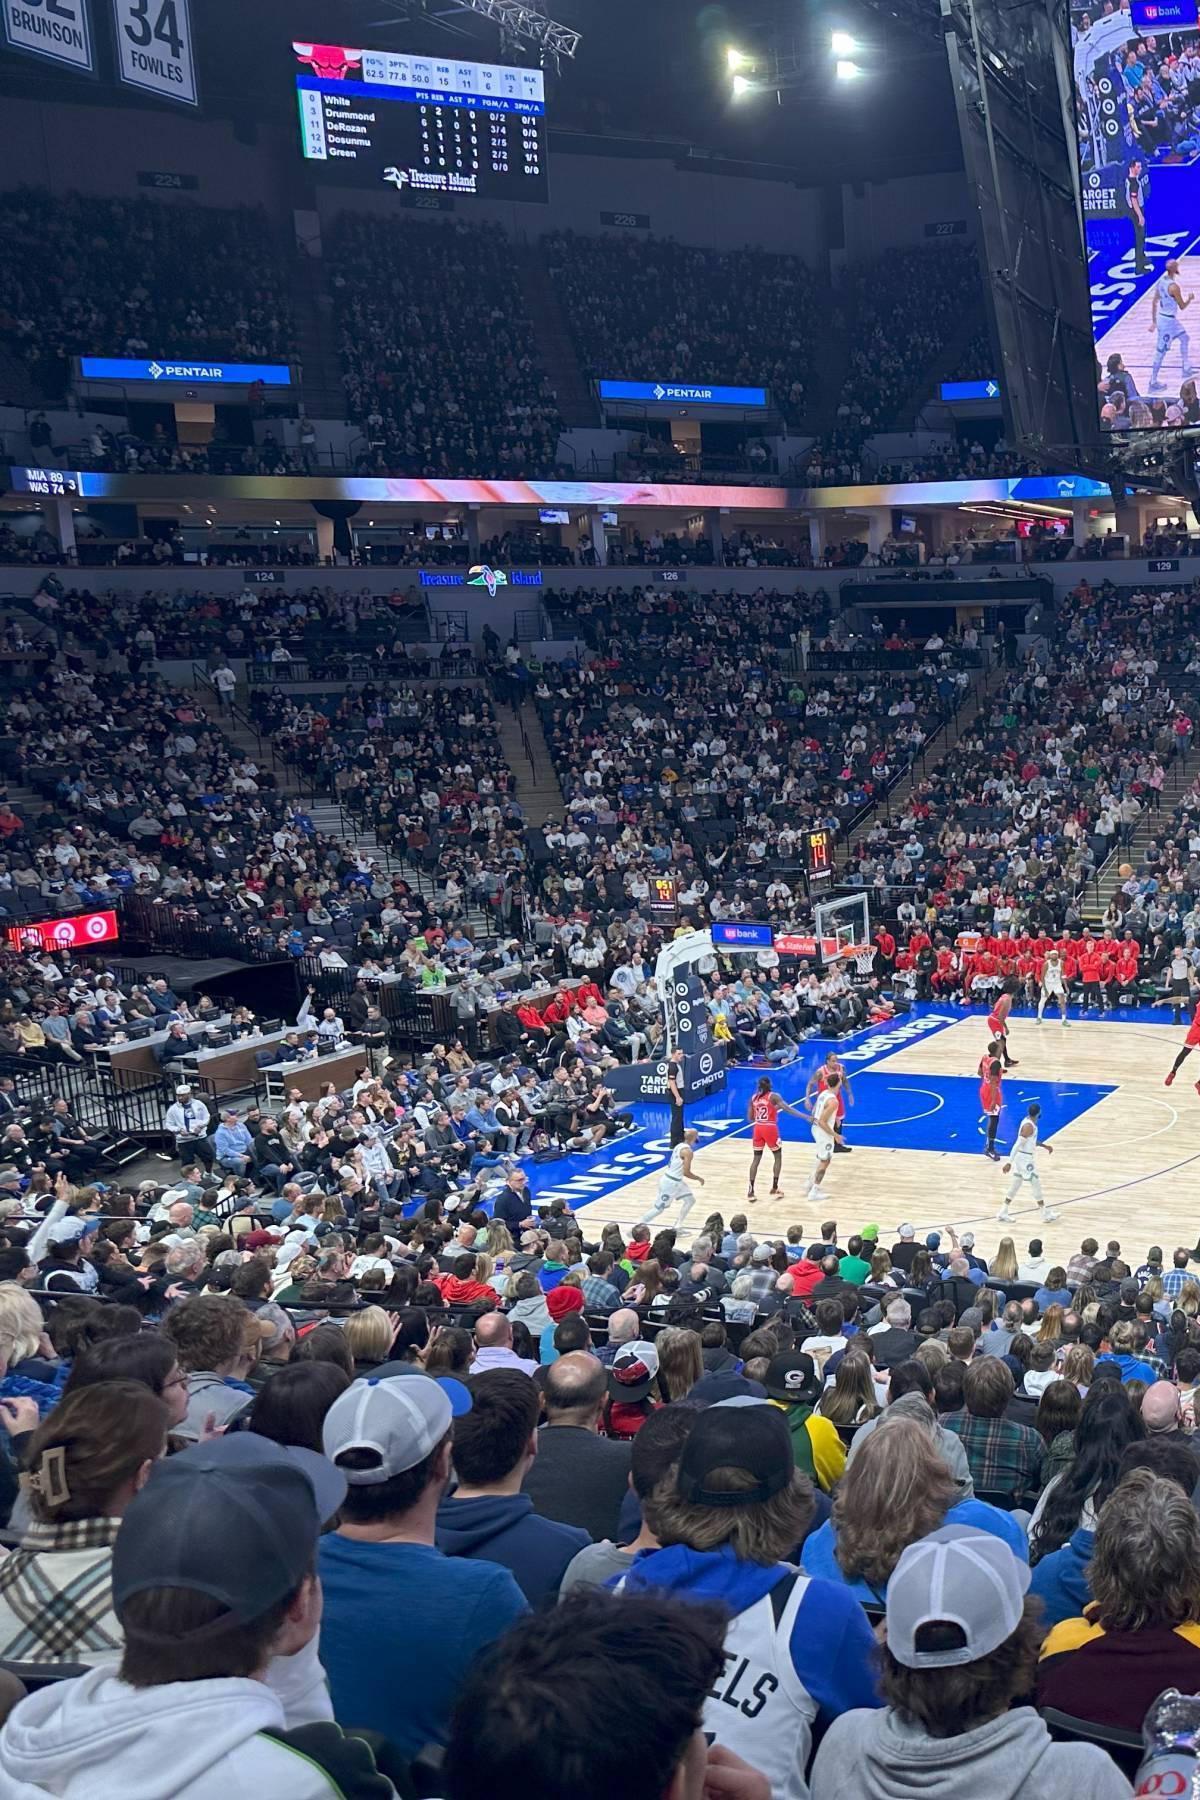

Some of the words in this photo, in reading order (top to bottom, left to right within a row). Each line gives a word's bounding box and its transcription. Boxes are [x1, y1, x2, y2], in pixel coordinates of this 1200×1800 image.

[1158, 7, 1181, 16] bank
[11, 7, 83, 49] BRUNSON
[124, 0, 183, 59] 34
[131, 50, 183, 83] FOWLES
[389, 61, 409, 69] 3PT%
[366, 69, 384, 78] 62.5
[388, 72, 407, 81] 77.8
[412, 74, 430, 83] 50.0
[439, 78, 449, 86] 15
[462, 80, 471, 88] 11
[508, 85, 513, 93] 2
[416, 92, 429, 100] PTS
[309, 94, 315, 102] 0
[324, 95, 351, 106] White
[420, 106, 426, 114] 0
[435, 107, 441, 116] 2
[454, 109, 458, 117] 1
[469, 110, 475, 119] 0
[489, 113, 505, 122] 0/2
[522, 116, 536, 125] 0/1
[310, 107, 316, 115] 3
[325, 109, 376, 122] Drummond
[436, 120, 443, 128] 3
[454, 122, 460, 130] 0
[471, 123, 476, 132] 1
[490, 125, 506, 134] 3/4
[522, 129, 537, 138] 0/0
[310, 120, 319, 128] 11
[327, 122, 367, 134] DeRozan
[422, 131, 428, 139] 4
[438, 132, 443, 141] 1
[454, 134, 460, 142] 3
[471, 135, 477, 144] 0
[491, 138, 507, 147] 2/5
[523, 141, 538, 150] 0/0
[311, 133, 321, 142] 12
[328, 134, 371, 147] Dosunmu
[424, 144, 429, 152] 5
[439, 145, 444, 154] 1
[455, 147, 462, 155] 3
[472, 149, 477, 157] 1
[492, 150, 508, 159] 2/2
[525, 154, 538, 162] 1/1
[312, 146, 322, 154] 24
[329, 148, 357, 158] Green
[424, 156, 430, 164] 0
[440, 157, 445, 166] 0
[456, 159, 462, 167] 0
[472, 160, 478, 169] 0
[492, 162, 508, 172] 0/0
[524, 166, 539, 175] 0/0
[154, 174, 181, 187] 224
[408, 168, 446, 184] Treasure
[448, 173, 477, 187] Island
[1083, 188, 1115, 199] ARGET
[415, 197, 440, 209] 225
[1083, 199, 1116, 209] ENTER
[614, 214, 636, 226] 226
[936, 224, 954, 234] 227
[165, 367, 222, 378] PENTAIR
[667, 388, 712, 398] PENTAIR
[27, 470, 48, 481] MIA
[50, 472, 64, 483] 89
[30, 482, 49, 493] WAS
[51, 483, 64, 495] 74
[68, 480, 76, 490] 3
[1156, 562, 1172, 571] 129
[254, 572, 274, 582] 124
[418, 570, 463, 586] Treasure
[662, 572, 678, 581] 126
[813, 845, 826, 868] 14
[660, 890, 670, 900] 14
[725, 928, 736, 937] us
[737, 928, 758, 938] bank
[836, 1013, 958, 1060] betway
[641, 1075, 667, 1085] TARG
[691, 1070, 724, 1090] CFMOTO
[640, 1085, 668, 1094] CENT
[756, 1107, 768, 1120] 12
